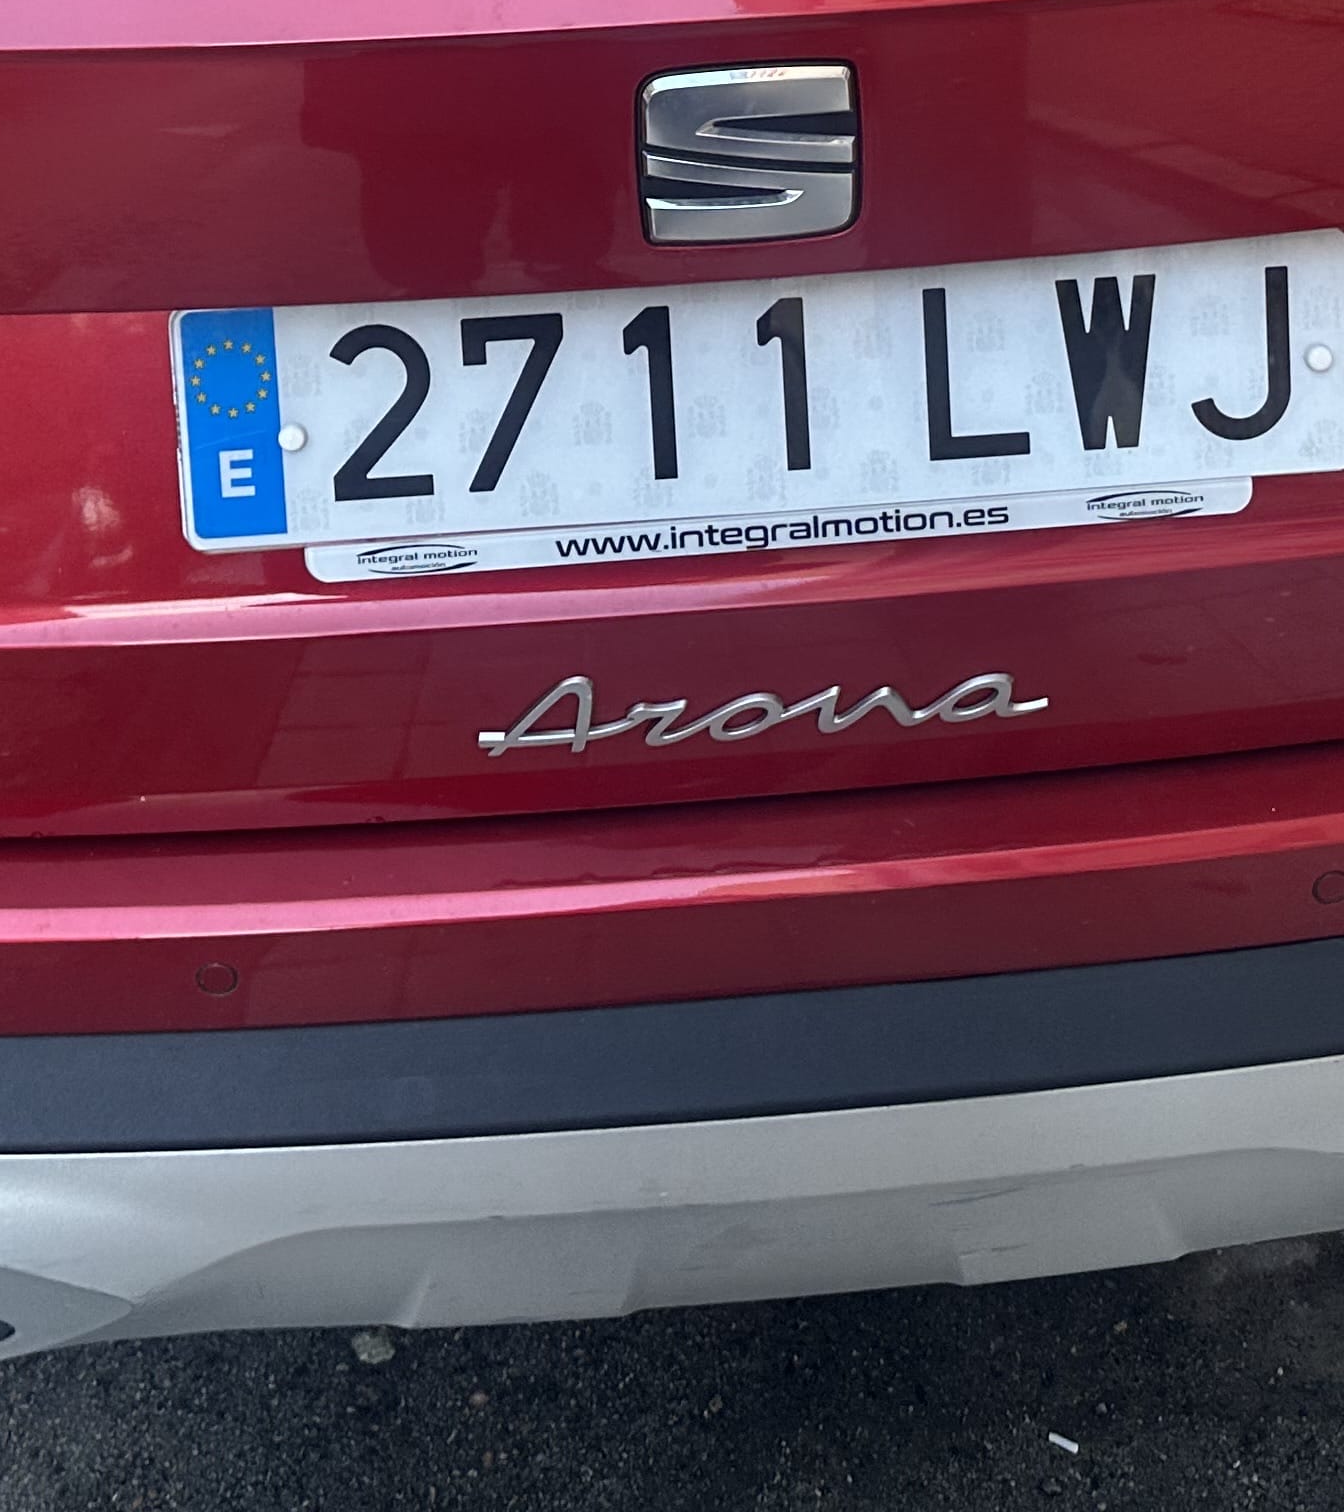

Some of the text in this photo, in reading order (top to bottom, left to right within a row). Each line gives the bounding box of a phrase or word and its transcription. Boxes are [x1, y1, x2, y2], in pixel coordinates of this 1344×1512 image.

[329, 265, 1292, 502] 2711 LWJ
[219, 448, 256, 498] E
[1087, 494, 1204, 511] integral motion
[423, 548, 478, 560] motion
[555, 504, 1010, 558] www.integralmotion.es
[477, 672, 1049, 757] Arona
